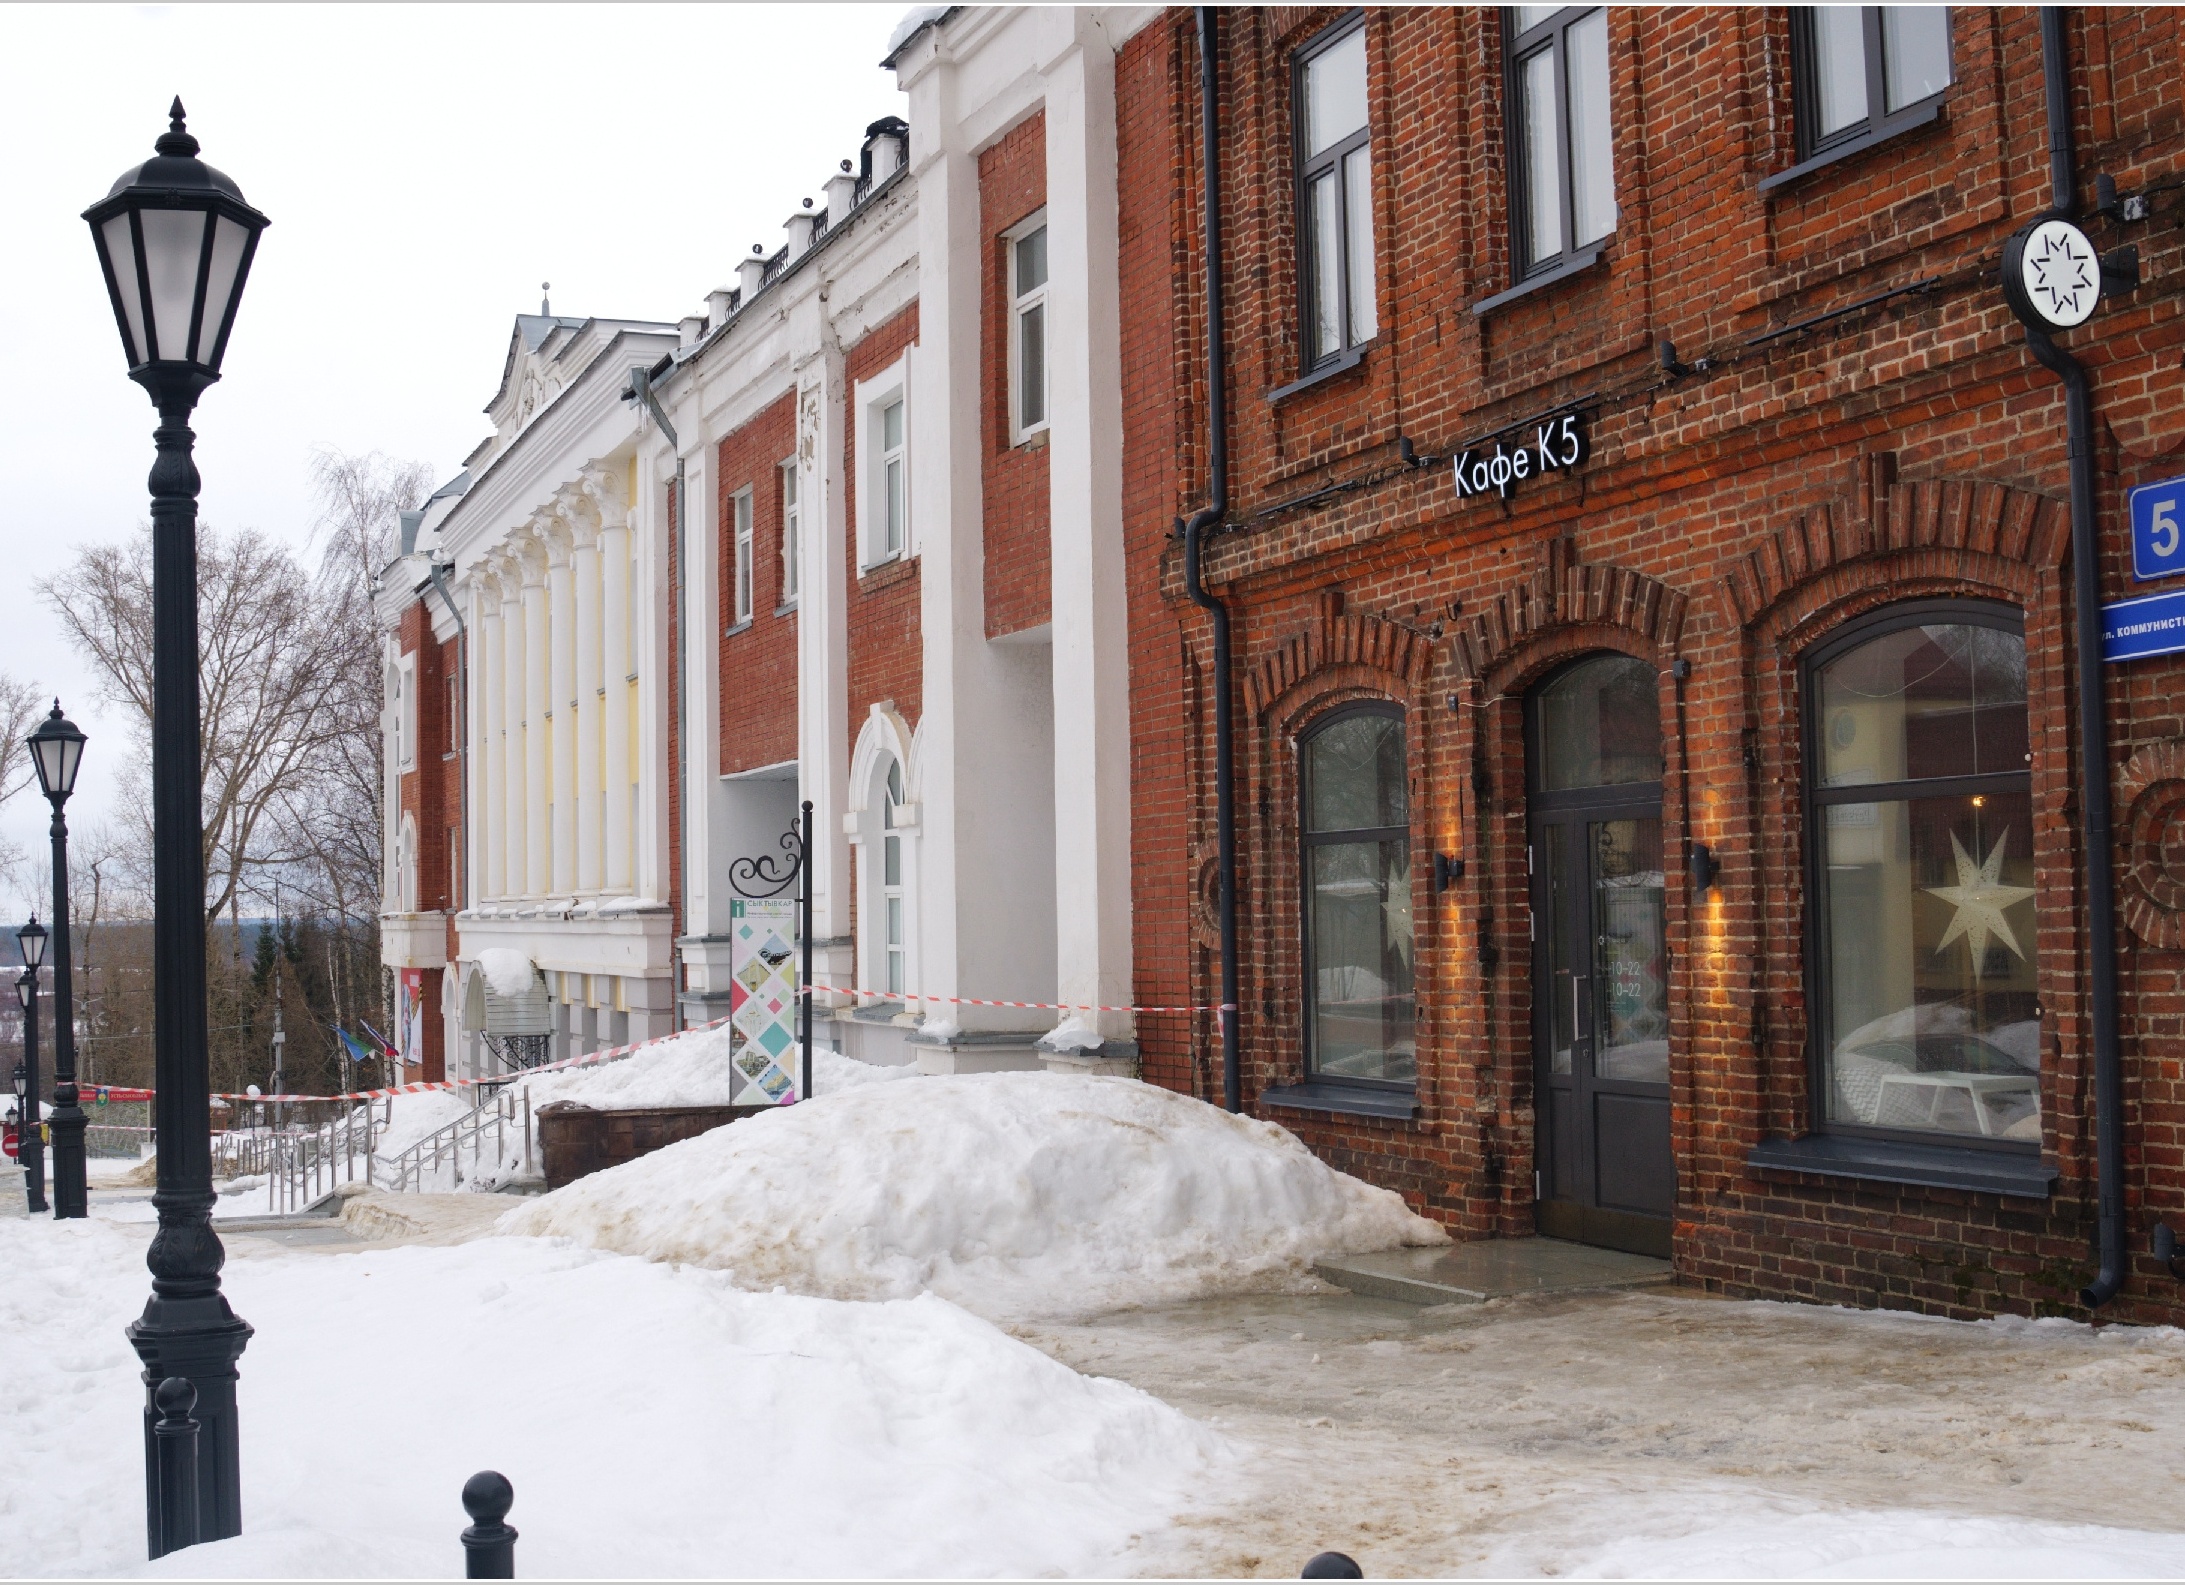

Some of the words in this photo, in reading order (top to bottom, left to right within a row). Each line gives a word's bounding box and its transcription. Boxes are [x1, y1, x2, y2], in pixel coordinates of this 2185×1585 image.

[1453, 444, 1529, 498] Кафе
[1538, 415, 1579, 471] К5
[2150, 499, 2180, 557] 5
